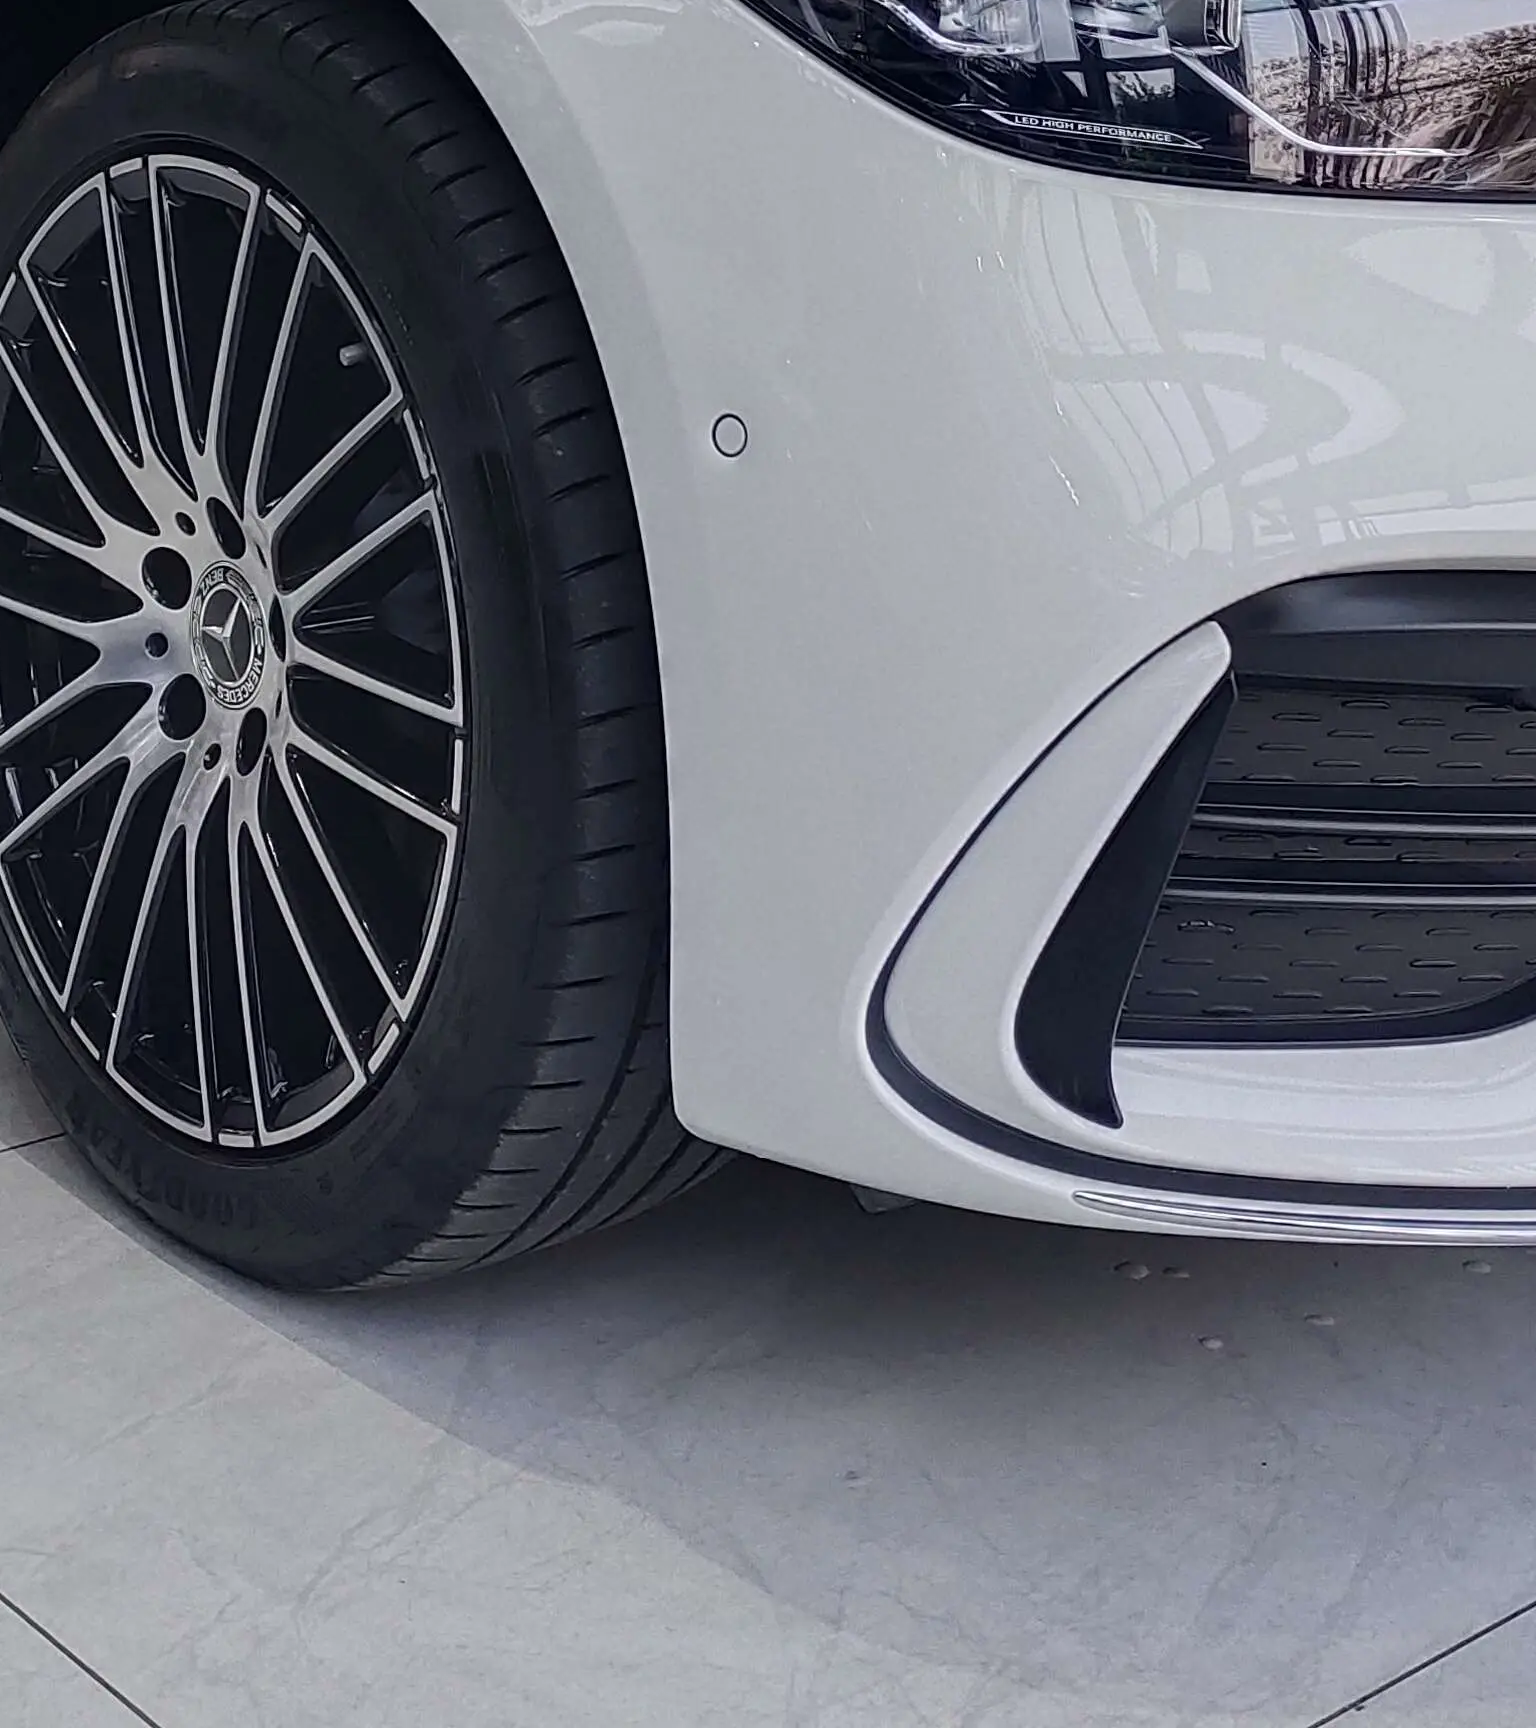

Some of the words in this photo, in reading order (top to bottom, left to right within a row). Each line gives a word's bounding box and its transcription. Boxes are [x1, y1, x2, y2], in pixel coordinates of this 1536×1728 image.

[1014, 115, 1039, 126] LED
[1042, 119, 1074, 131] HIGH
[1077, 123, 1173, 143] PERFORMANCE
[200, 567, 224, 595] BENZ
[217, 657, 263, 703] MERCEDES
